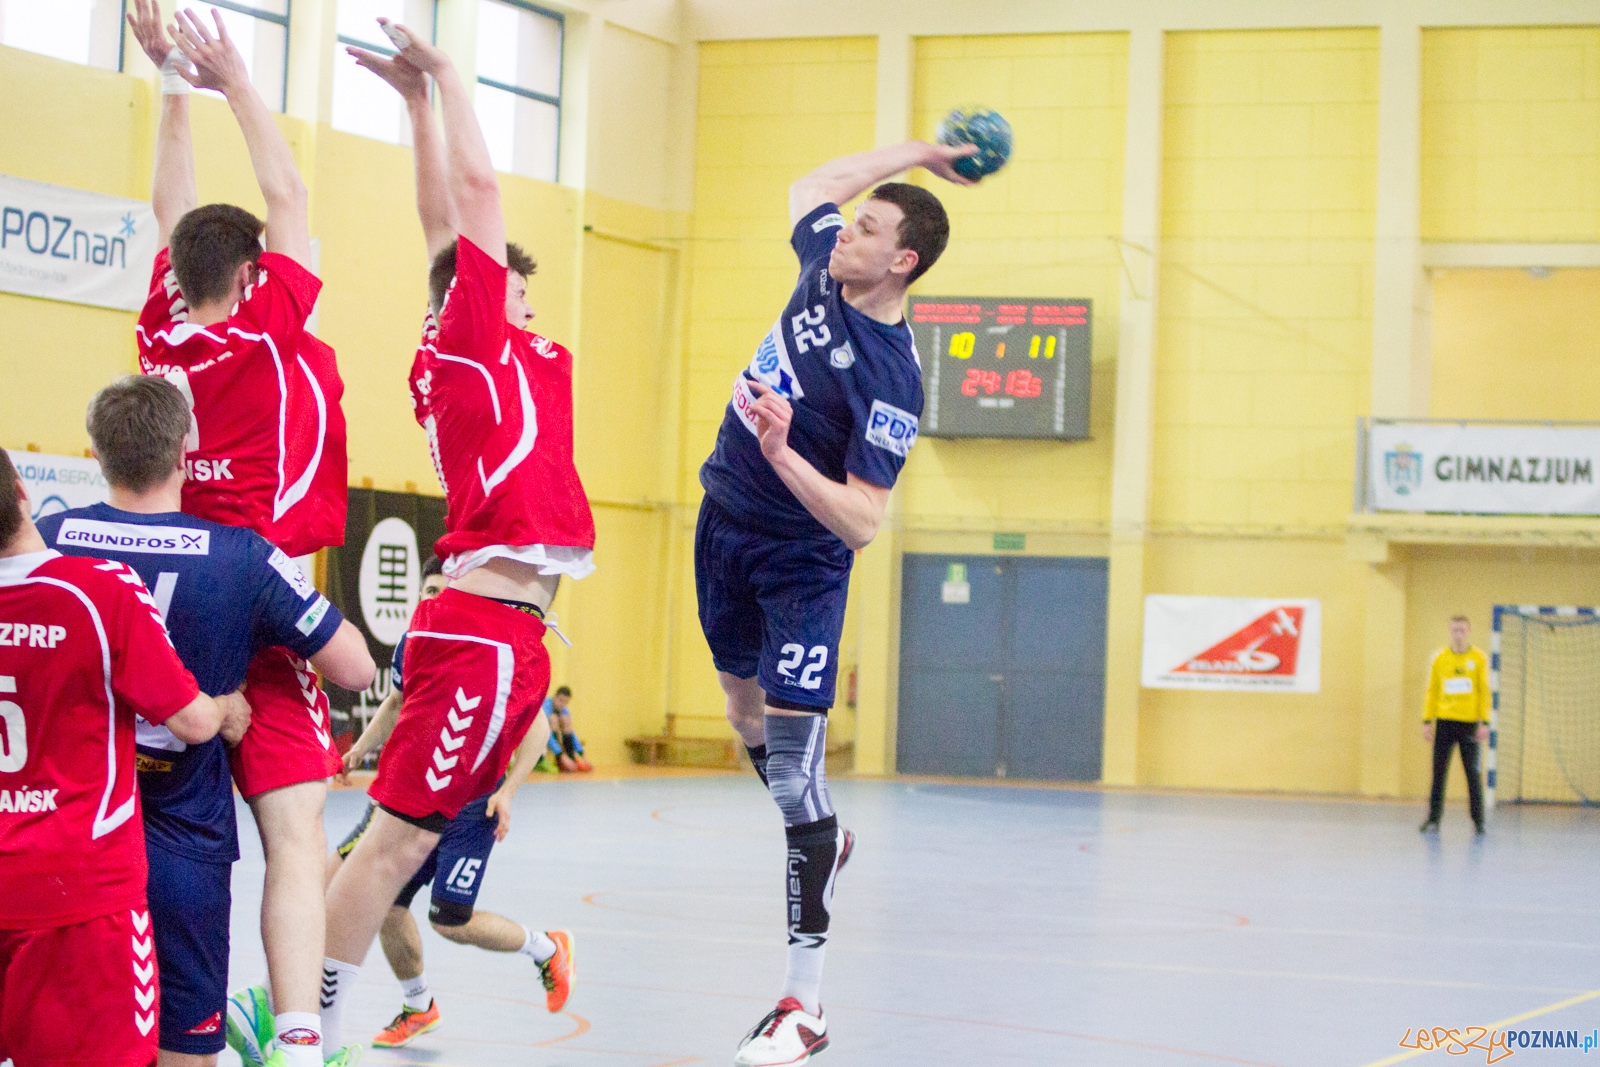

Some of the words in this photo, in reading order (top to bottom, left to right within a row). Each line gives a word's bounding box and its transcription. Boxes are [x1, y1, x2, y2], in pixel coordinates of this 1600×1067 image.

[792, 304, 832, 354] 22
[949, 332, 976, 359] 10
[1029, 335, 1056, 359] 11
[1434, 455, 1593, 484] GIMNAZJUM
[64, 530, 176, 549] GRUNDFOS
[777, 643, 828, 689] 22
[446, 856, 482, 889] 15
